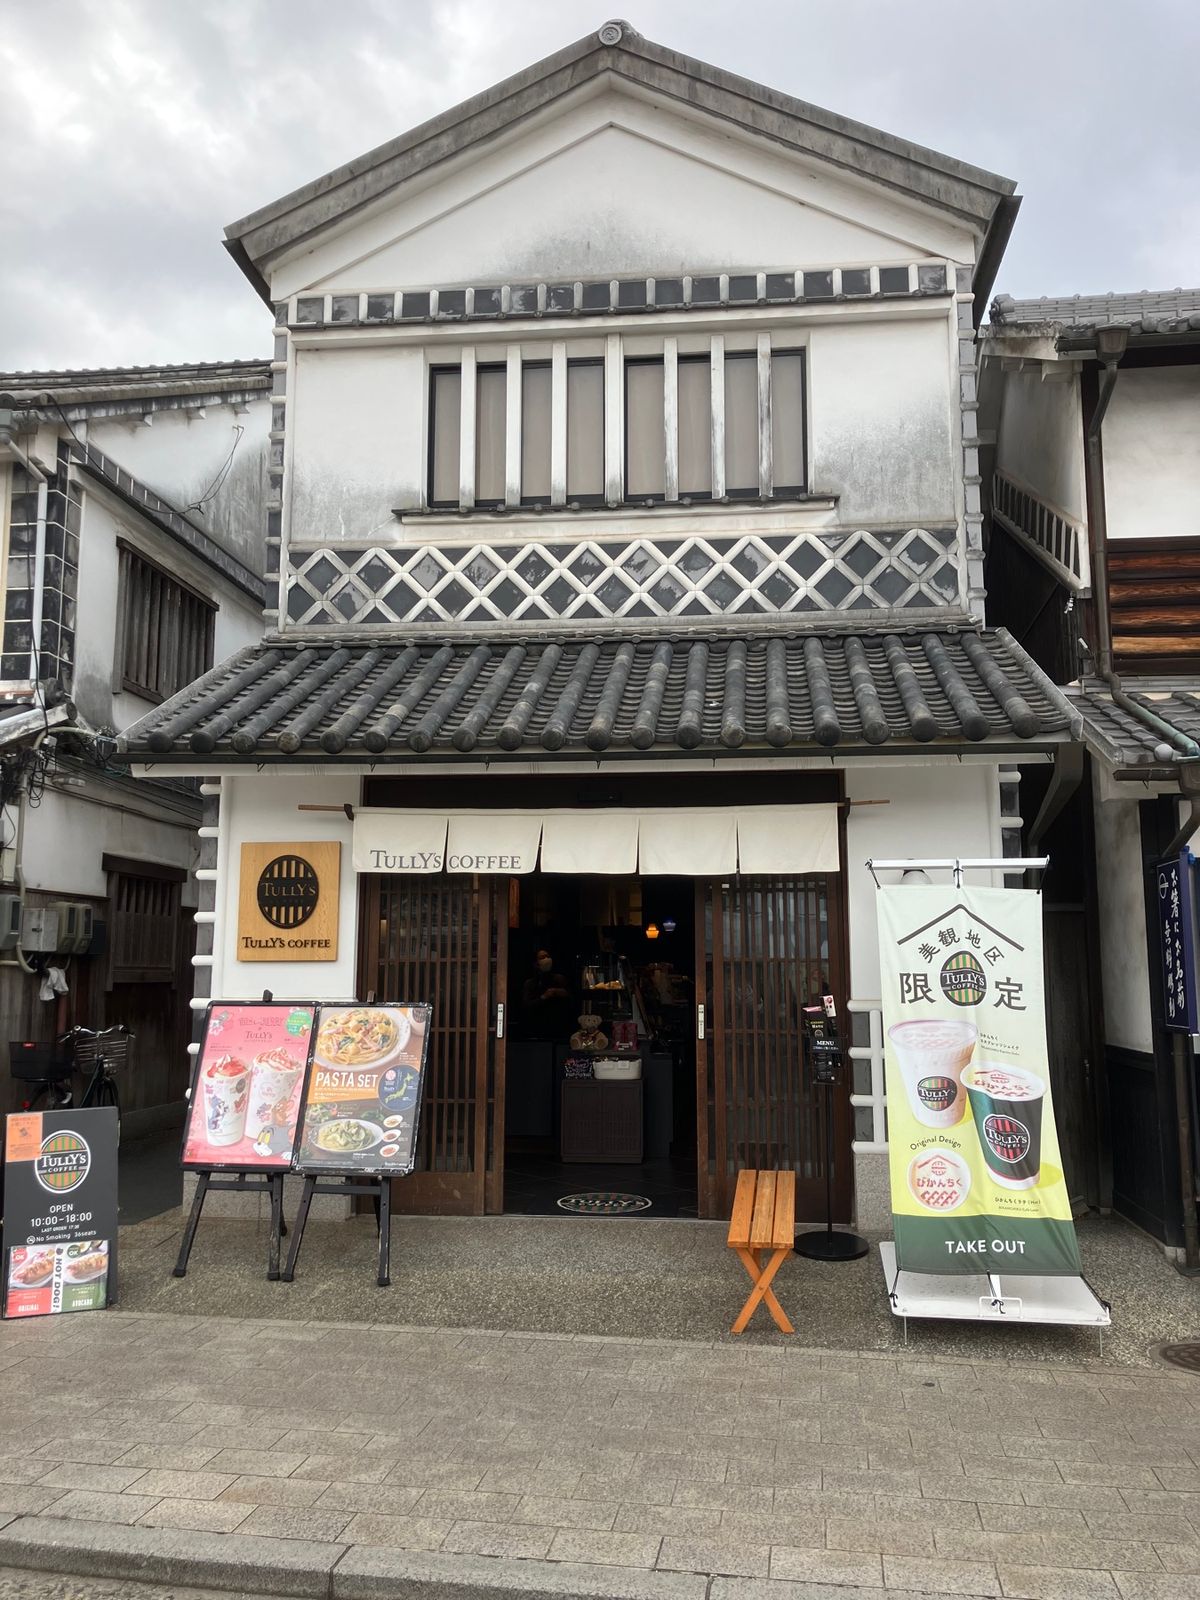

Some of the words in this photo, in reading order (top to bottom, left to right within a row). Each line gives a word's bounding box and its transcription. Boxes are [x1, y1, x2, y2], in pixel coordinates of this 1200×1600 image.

[449, 855, 521, 869] COFFEE
[287, 939, 331, 949] COFFEE
[918, 928, 1005, 967] 美観地区
[951, 982, 979, 990] COFFEE
[315, 1071, 354, 1088] PASTA
[357, 1074, 378, 1088] SET
[910, 1136, 937, 1151] Original
[938, 1136, 962, 1149] Design
[48, 1165, 78, 1173] COFFEE
[49, 1203, 74, 1214] OPEN
[46, 1233, 71, 1241] Smoking
[945, 1240, 987, 1255] TAKE
[991, 1239, 1026, 1255] OUT
[55, 1258, 63, 1276] HOT
[53, 1282, 61, 1308] DOG!
